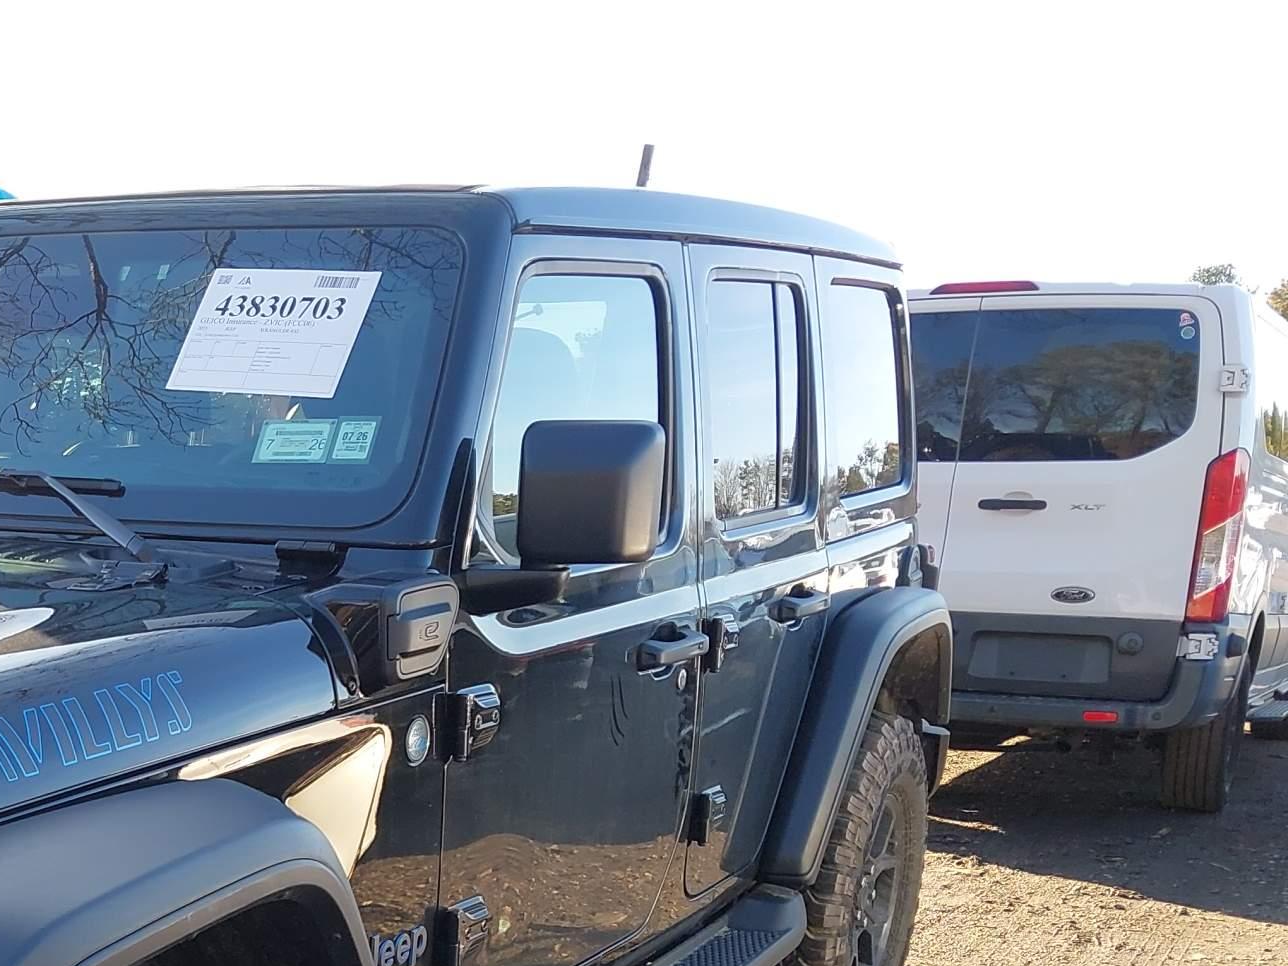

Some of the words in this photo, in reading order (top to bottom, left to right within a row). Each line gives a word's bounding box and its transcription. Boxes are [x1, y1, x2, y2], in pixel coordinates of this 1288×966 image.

[214, 294, 347, 320] 43830703
[342, 431, 354, 441] 07
[356, 431, 368, 441] 26
[265, 438, 276, 450] 7
